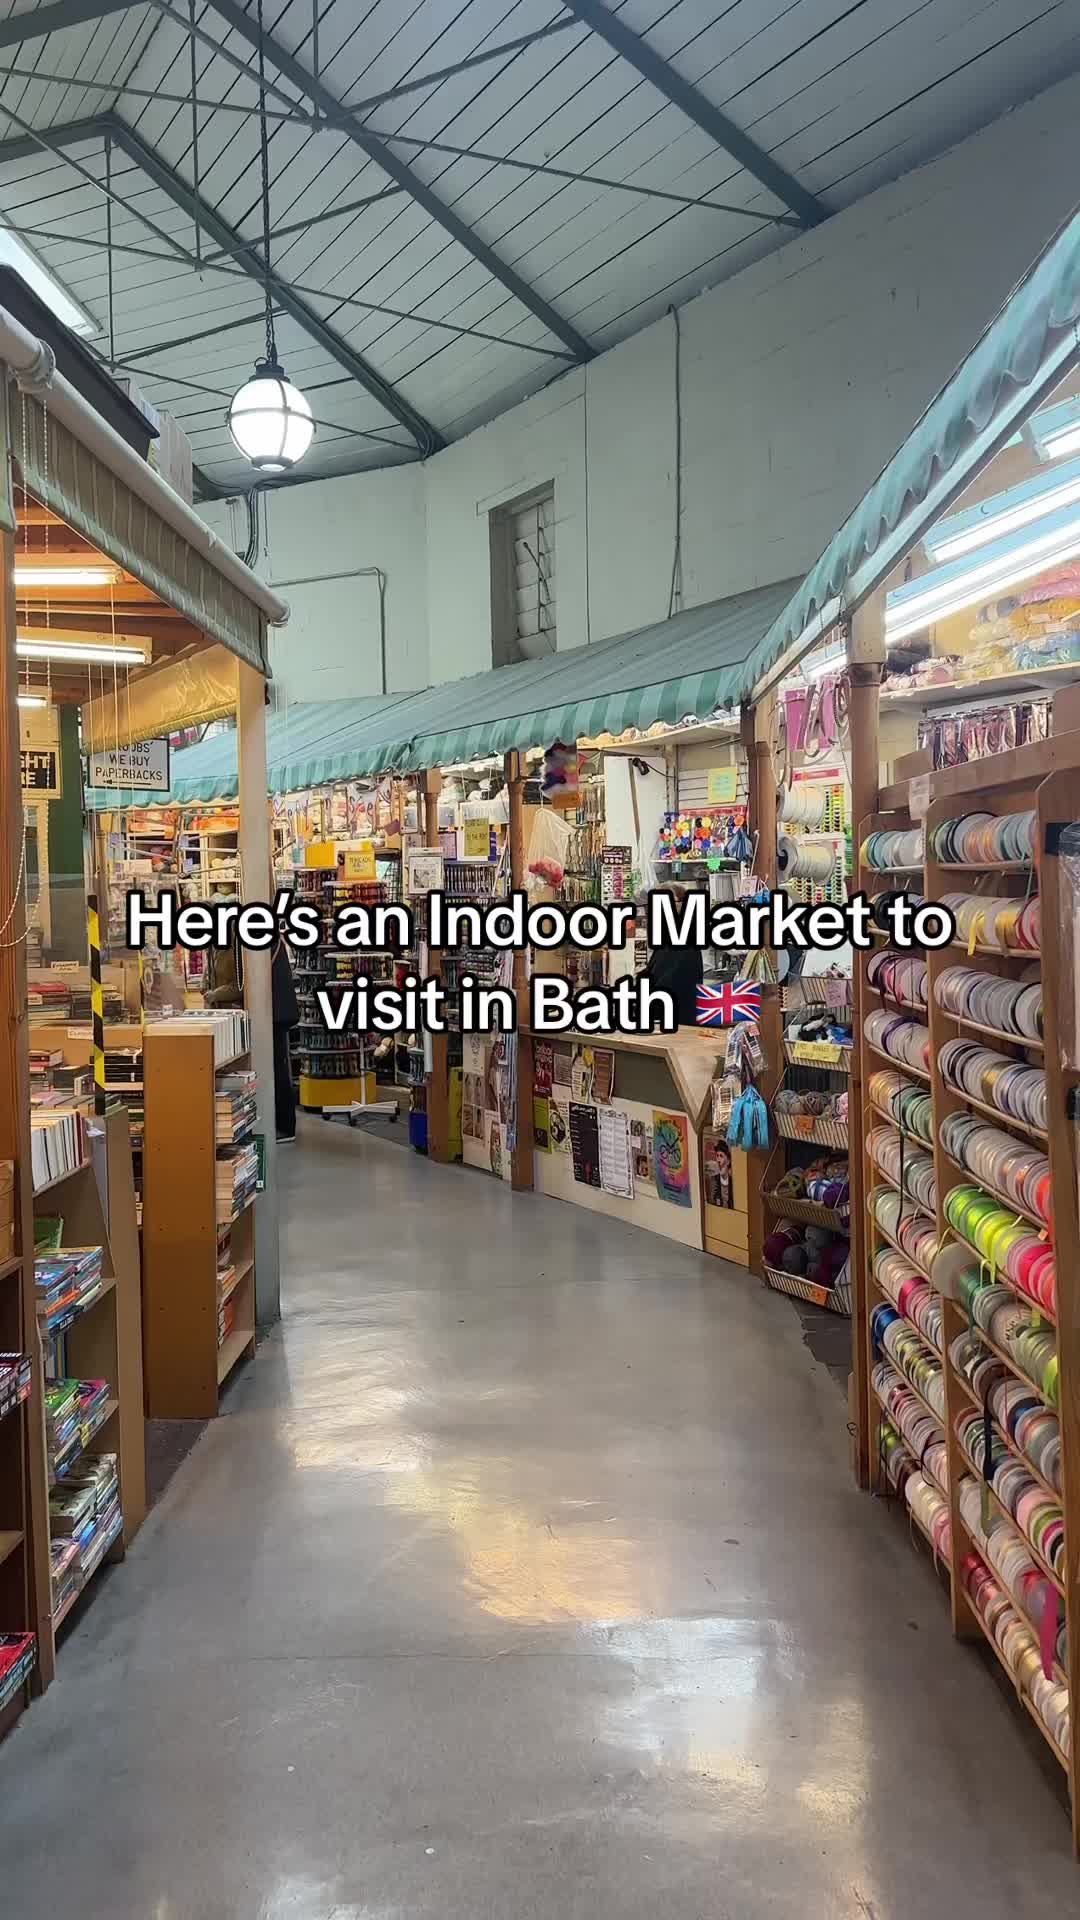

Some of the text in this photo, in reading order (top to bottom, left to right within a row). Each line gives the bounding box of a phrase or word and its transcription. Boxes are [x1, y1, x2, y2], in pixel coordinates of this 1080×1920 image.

[109, 753, 150, 767] WE BUY
[95, 766, 163, 781] PAPERBACKS
